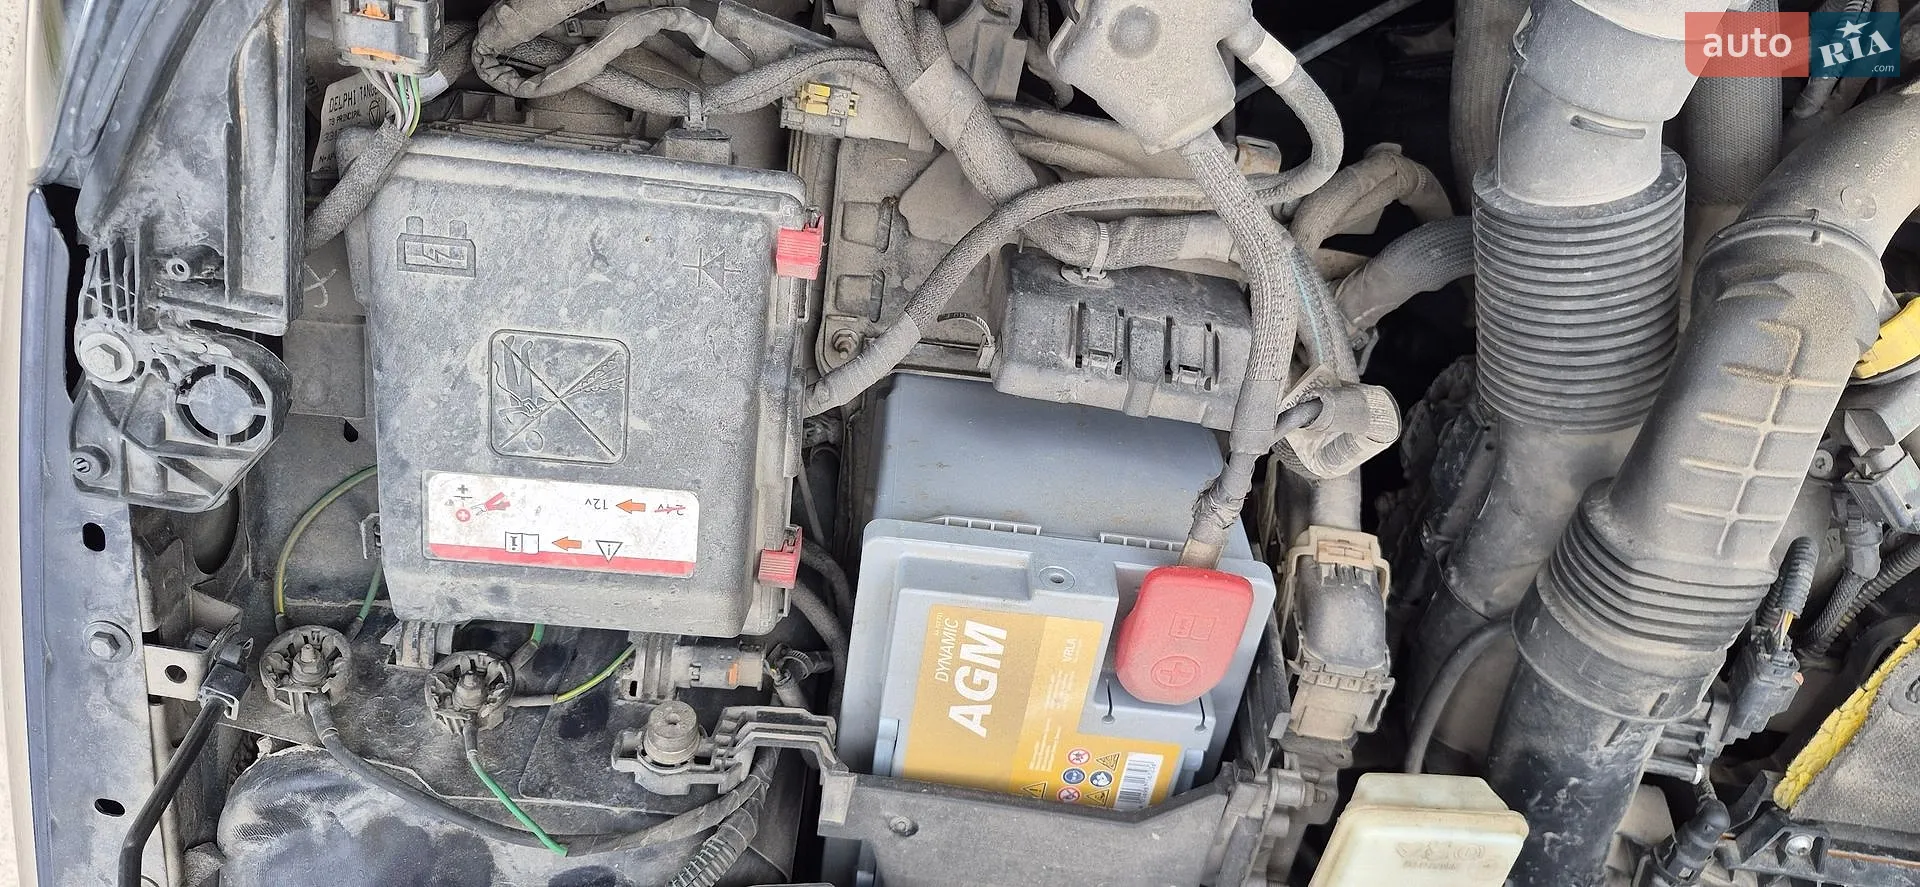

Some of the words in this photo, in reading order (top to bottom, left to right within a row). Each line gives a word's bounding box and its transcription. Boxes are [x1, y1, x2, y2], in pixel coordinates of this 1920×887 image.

[329, 90, 357, 113] DELPHI
[935, 617, 959, 682] DYNAMIC
[1063, 638, 1078, 663] VRLA
[948, 619, 1007, 738] AGM
